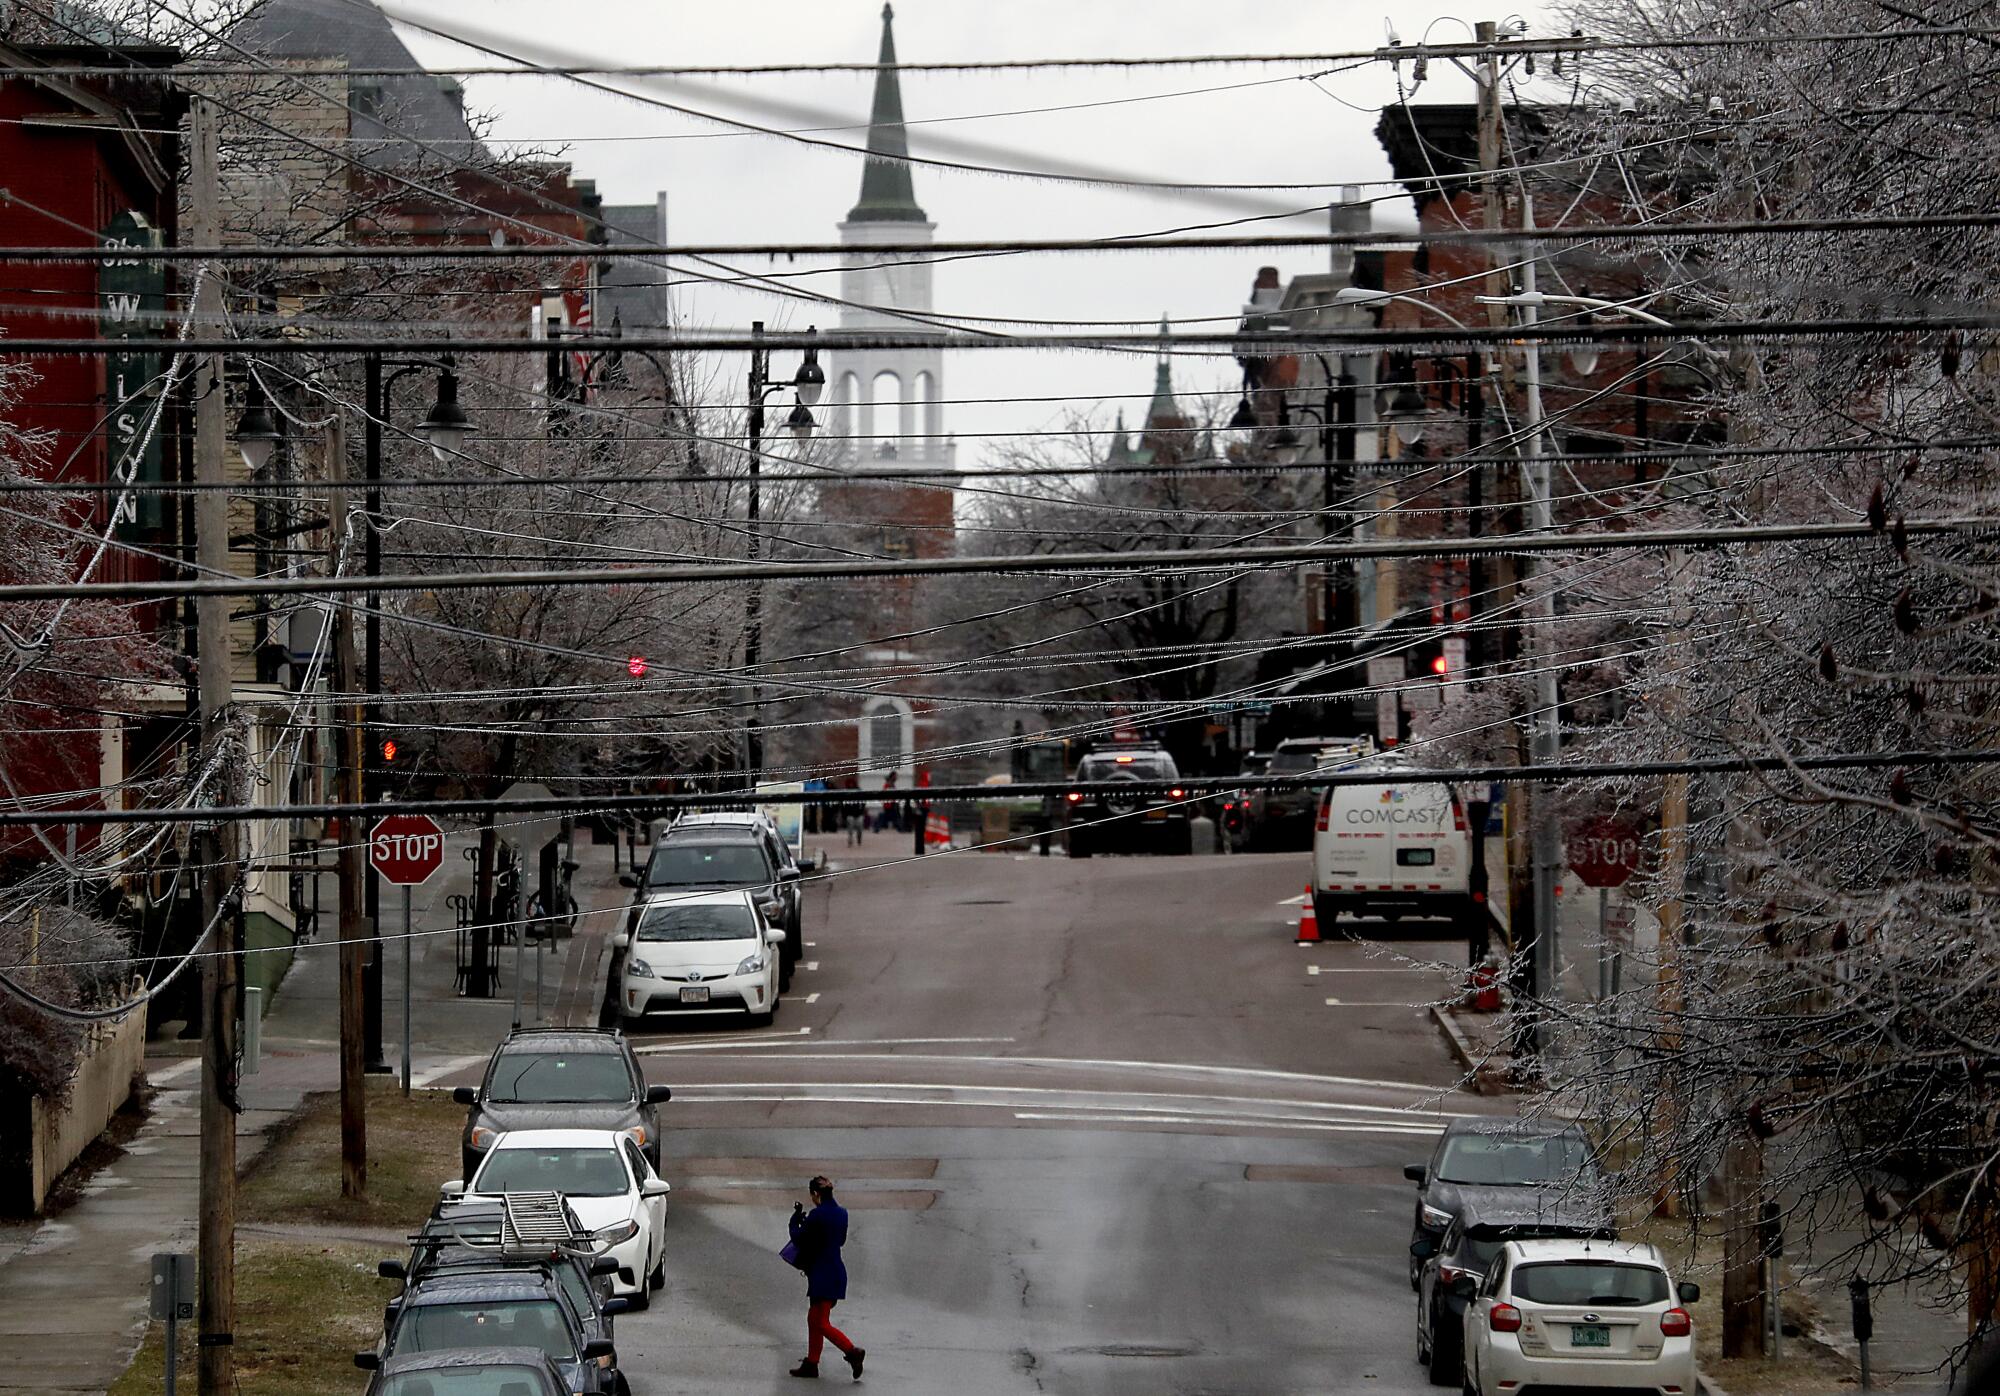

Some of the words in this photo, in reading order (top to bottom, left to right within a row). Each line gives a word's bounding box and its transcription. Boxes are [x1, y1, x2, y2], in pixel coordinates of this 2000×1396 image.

[107, 294, 141, 524] WILSON
[1346, 809, 1438, 824] COMCAST
[375, 834, 439, 861] STOP
[1568, 838, 1637, 865] STOP
